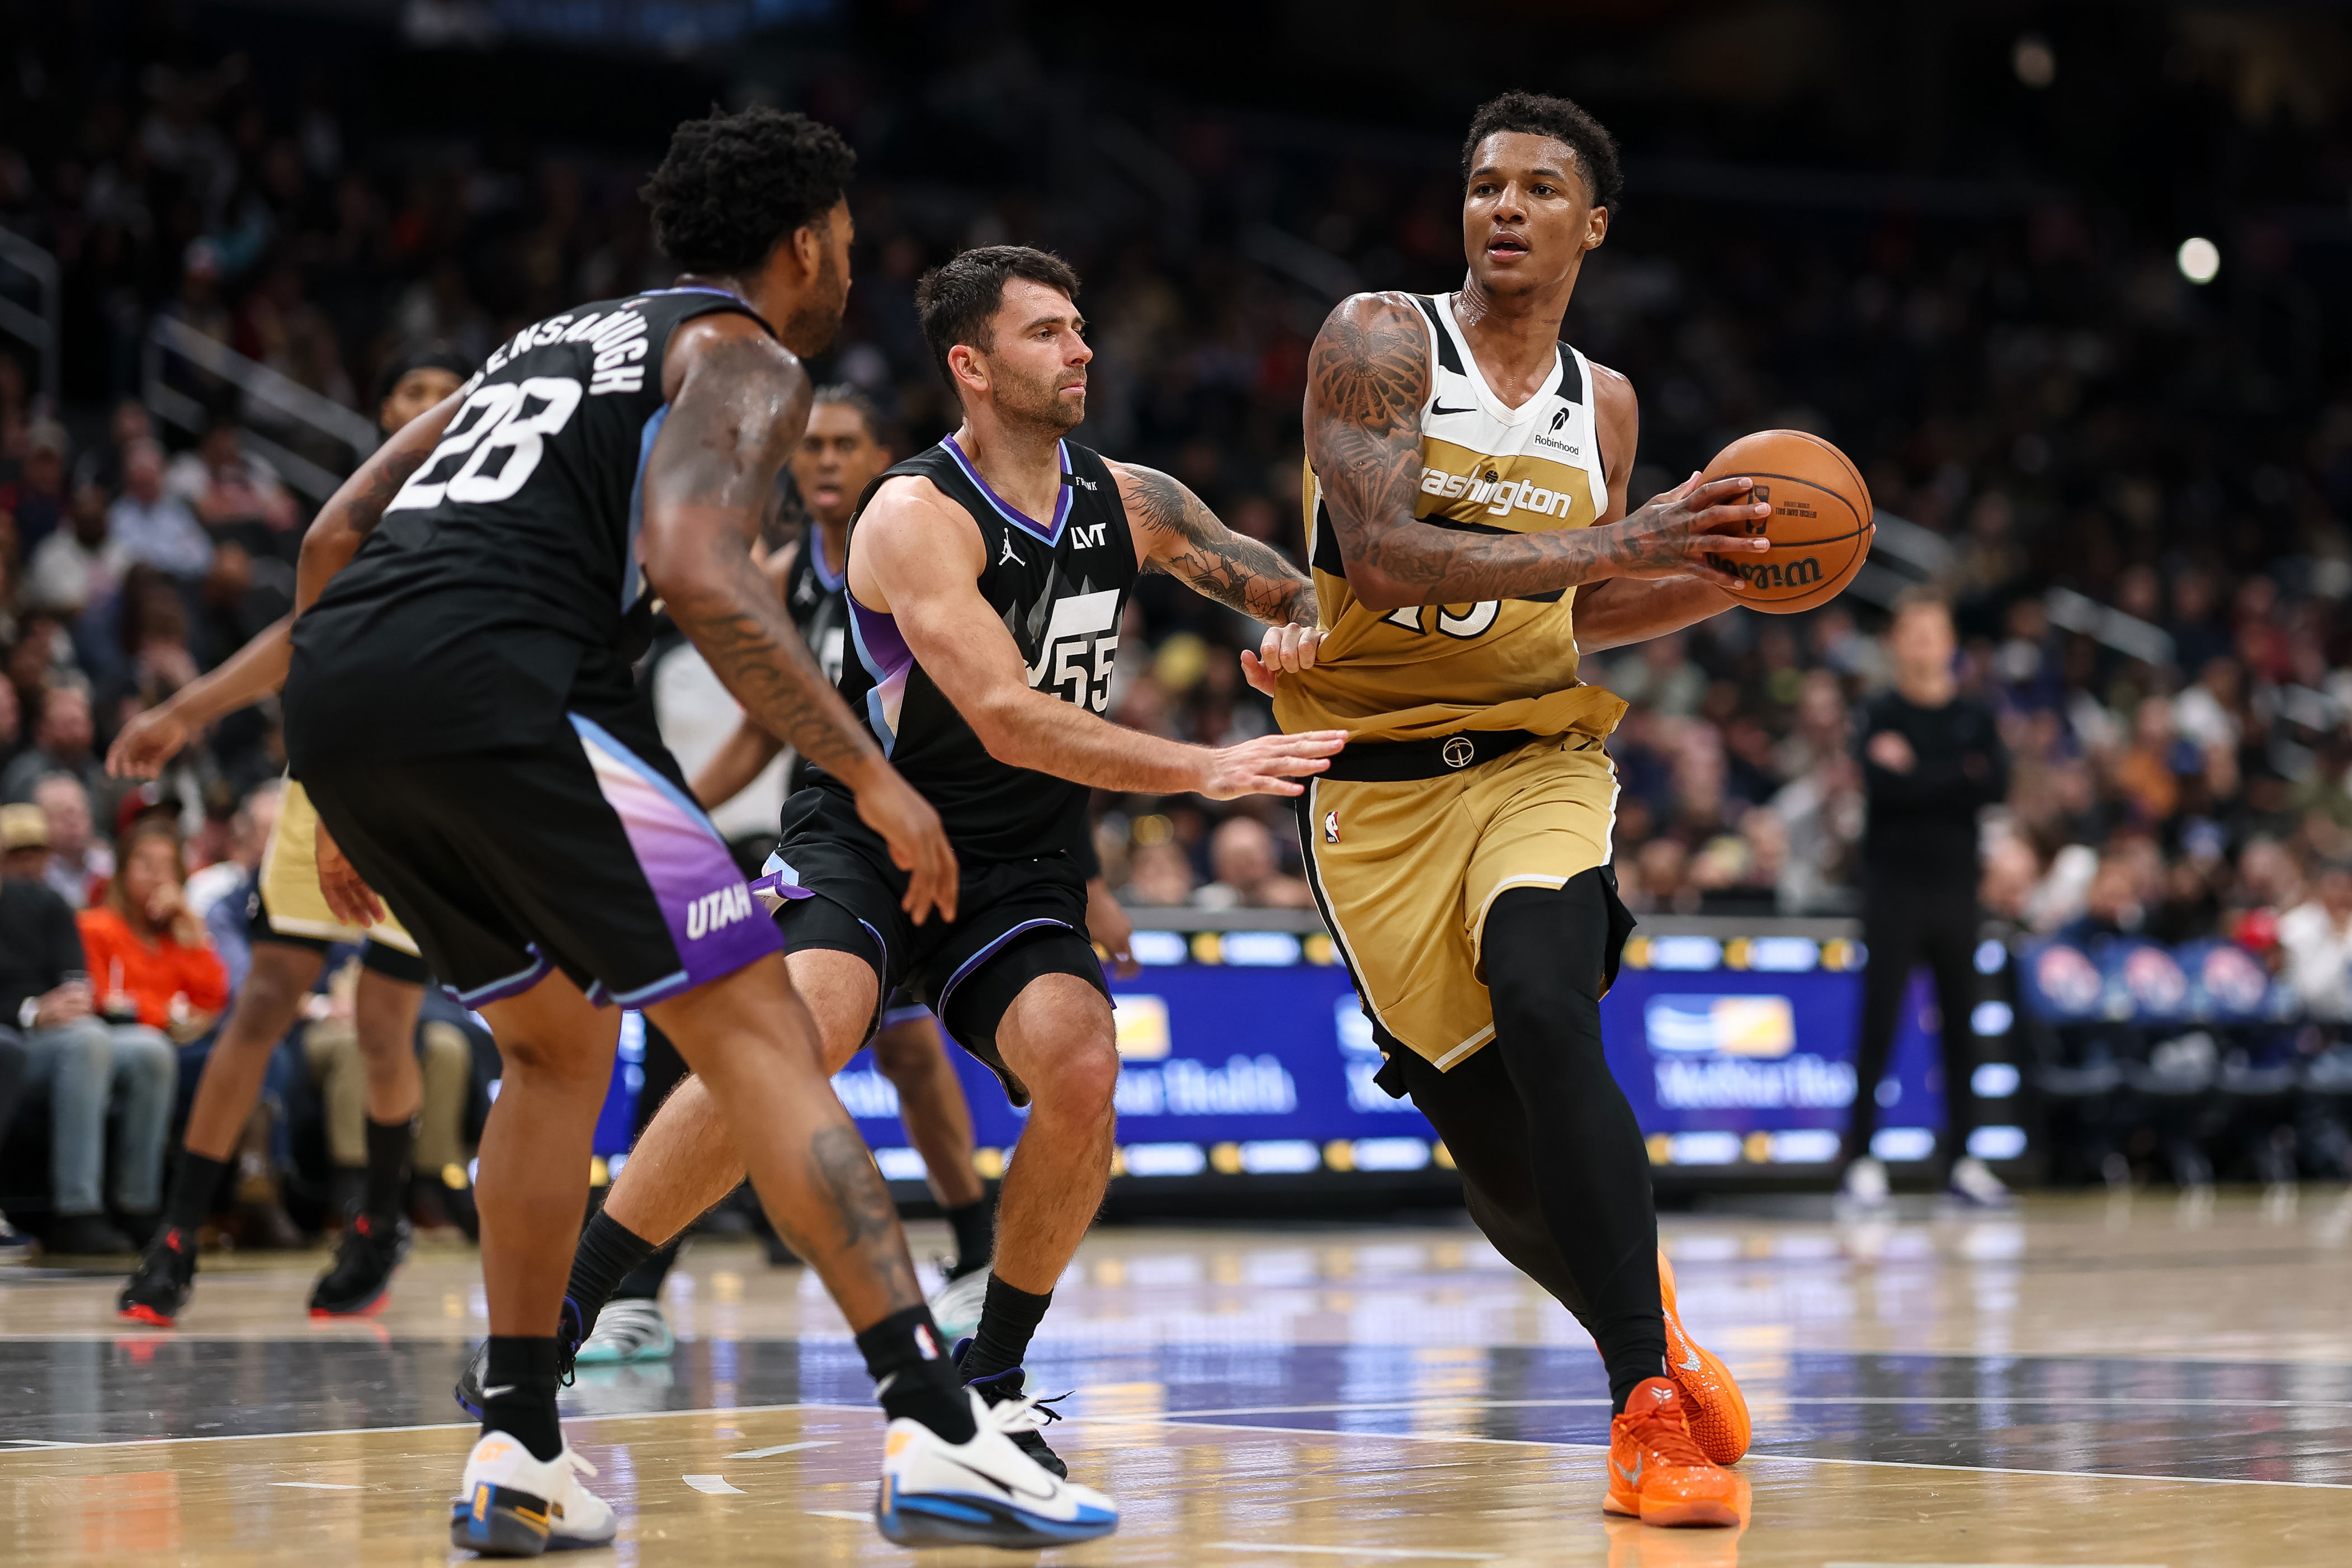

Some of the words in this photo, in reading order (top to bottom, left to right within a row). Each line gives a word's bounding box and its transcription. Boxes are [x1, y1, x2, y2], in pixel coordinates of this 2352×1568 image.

[382, 376, 583, 517] 28
[1535, 434, 1579, 455] Robinhood
[1075, 476, 1098, 490] FRANK
[1070, 522, 1107, 550] LVT
[1050, 635, 1119, 712] 55
[686, 880, 753, 941] UTAH
